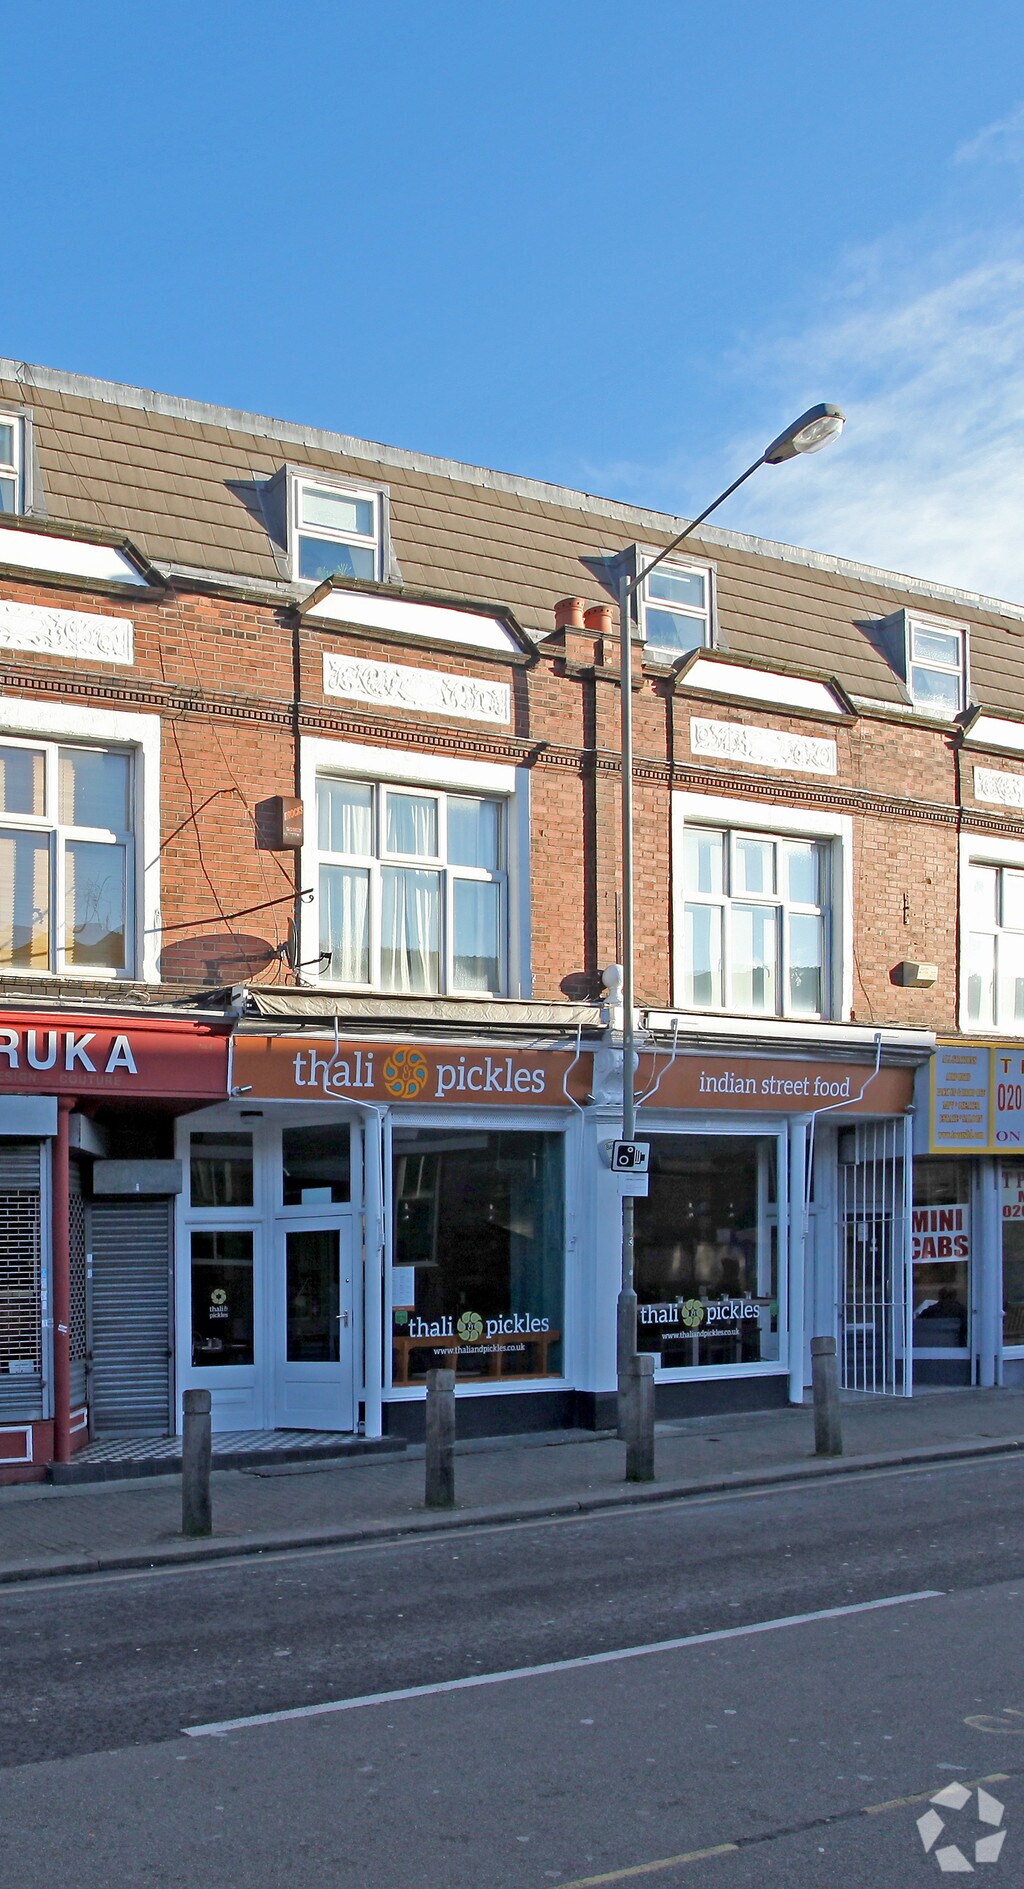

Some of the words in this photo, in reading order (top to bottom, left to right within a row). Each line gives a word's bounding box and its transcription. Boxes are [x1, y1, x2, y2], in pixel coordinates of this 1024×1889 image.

[59, 1074, 121, 1087] COUTURE
[293, 1049, 374, 1088] thali
[434, 1056, 545, 1098] pickles
[699, 1071, 757, 1094] indian
[761, 1075, 810, 1096] street
[813, 1075, 851, 1098] food
[998, 1083, 1022, 1112] 020
[913, 1208, 963, 1233] MINI
[912, 1235, 969, 1260] CABS
[640, 1304, 679, 1324] thali
[706, 1300, 760, 1325] pickles
[408, 1315, 454, 1337] thali
[485, 1312, 550, 1339] pickles
[433, 1342, 526, 1355] www.thaliandpickles.co.uk
